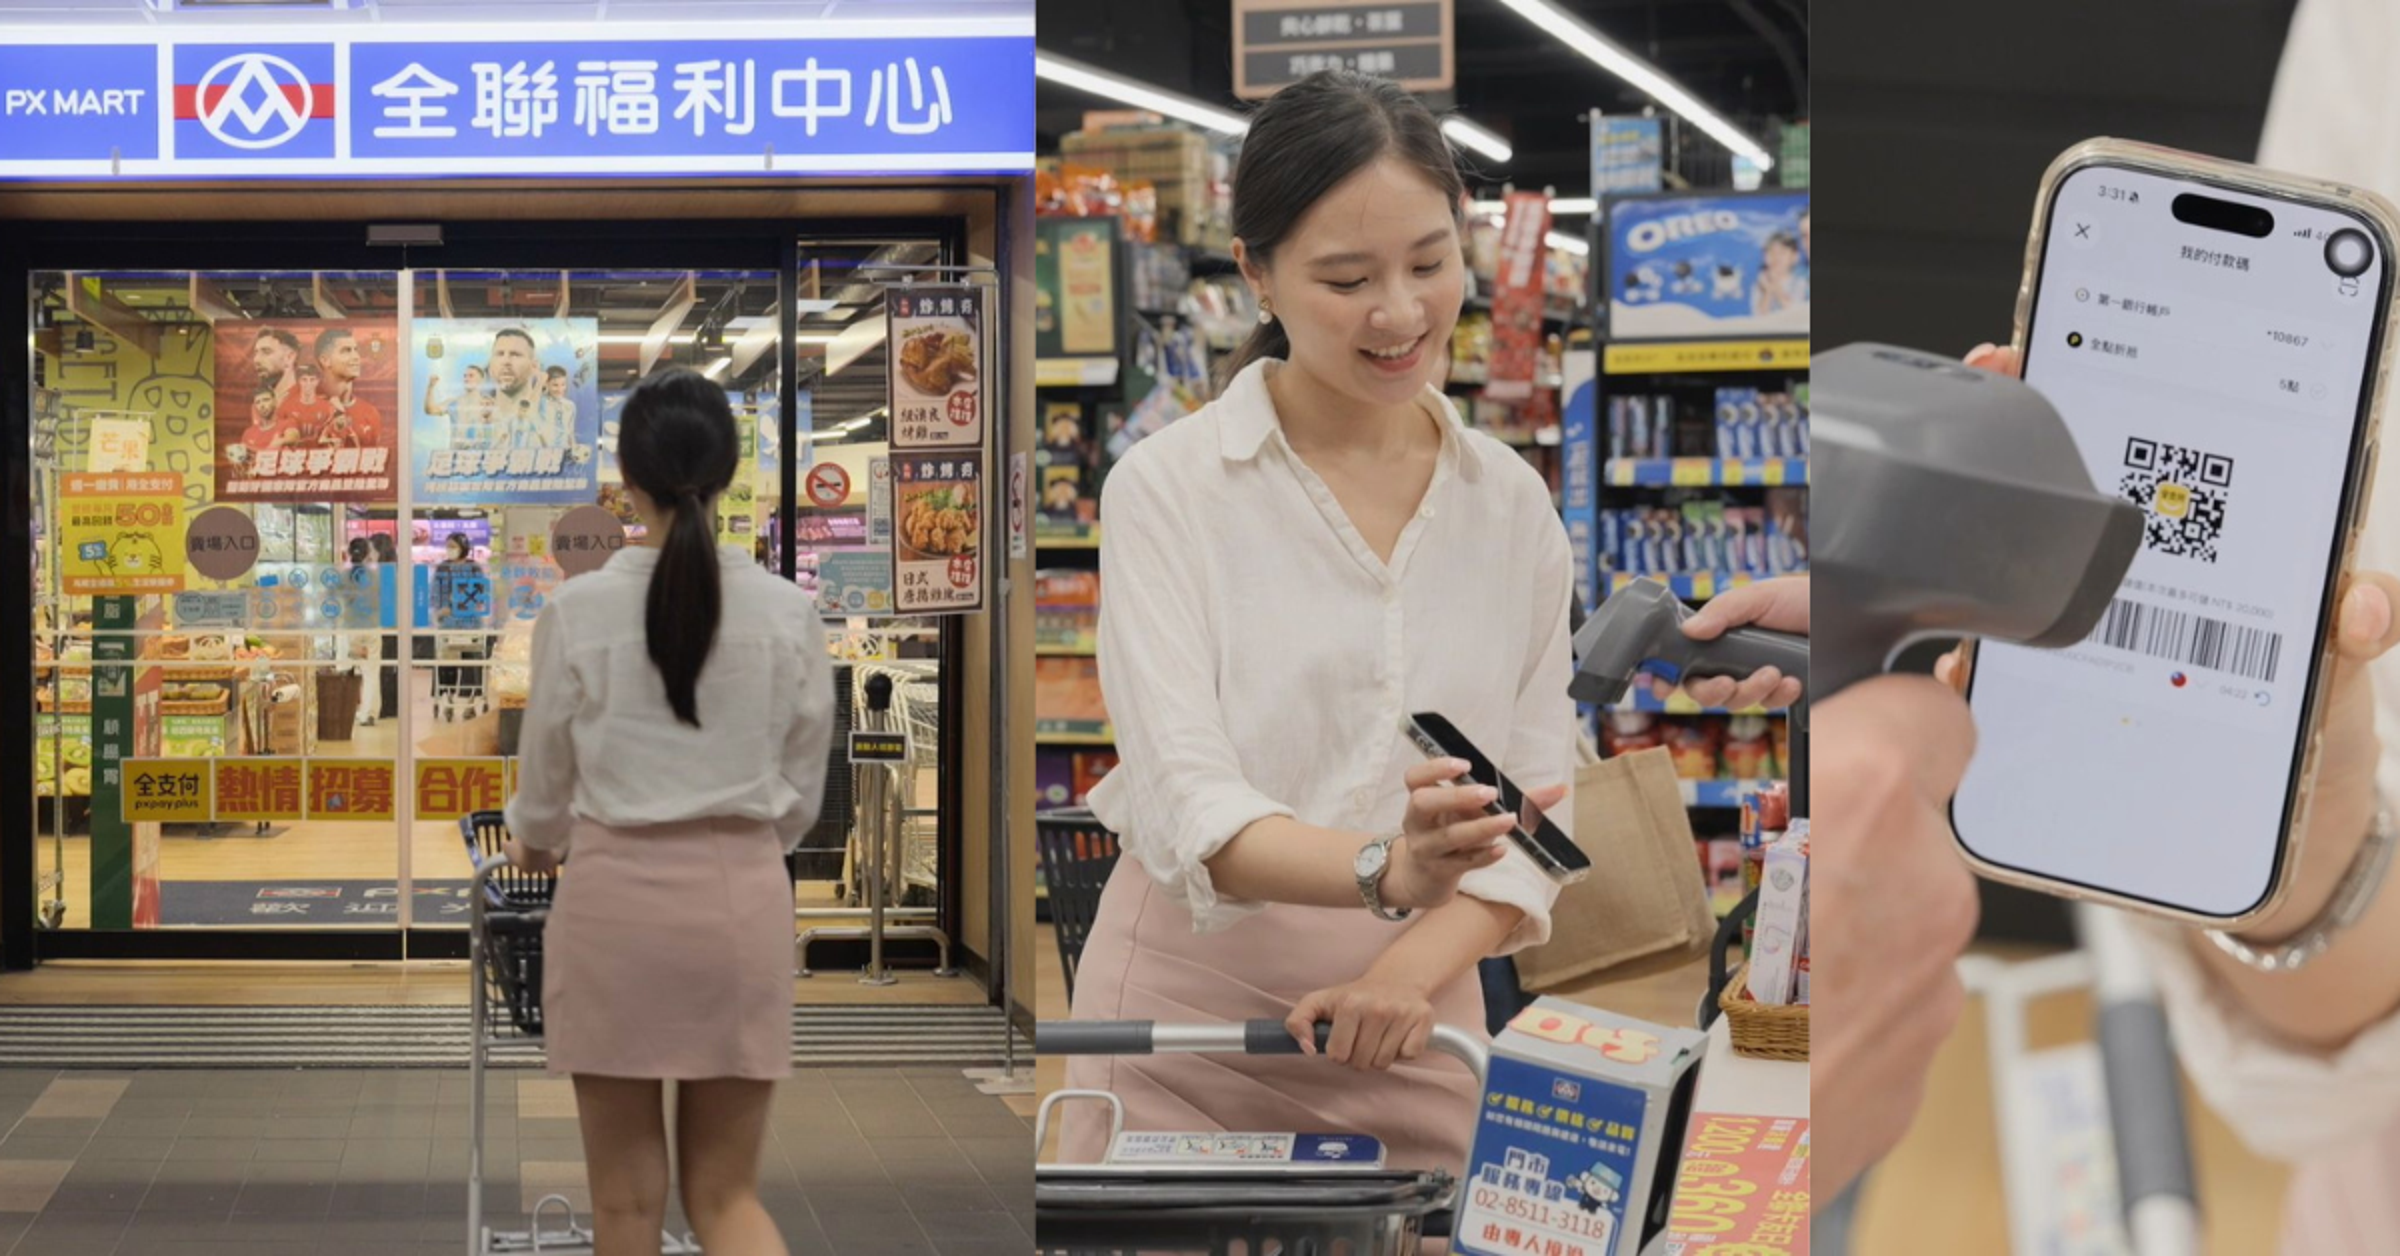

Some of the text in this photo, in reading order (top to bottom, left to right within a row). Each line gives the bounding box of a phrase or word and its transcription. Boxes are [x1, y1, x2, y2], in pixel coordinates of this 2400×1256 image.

[5, 88, 145, 116] PX MART
[371, 57, 953, 138] 全聯福利中心
[2098, 186, 2127, 202] 3:31
[1627, 209, 1739, 252] OREO
[2180, 246, 2250, 272] 我的付款碼
[2090, 338, 2139, 359] 全點折抵
[2279, 379, 2300, 394] 5點
[115, 502, 162, 528] 50
[190, 536, 256, 552] 賣場入口
[556, 534, 623, 551] 賣場入口
[903, 570, 930, 586] 日式
[134, 766, 503, 813] 全支付 熱情 招募 合作
[1605, 1120, 1635, 1141] 品質
[1507, 1150, 1547, 1175] 門市
[1482, 1165, 1563, 1202] 服務專線
[1475, 1187, 1605, 1240] 02-8511-3118
